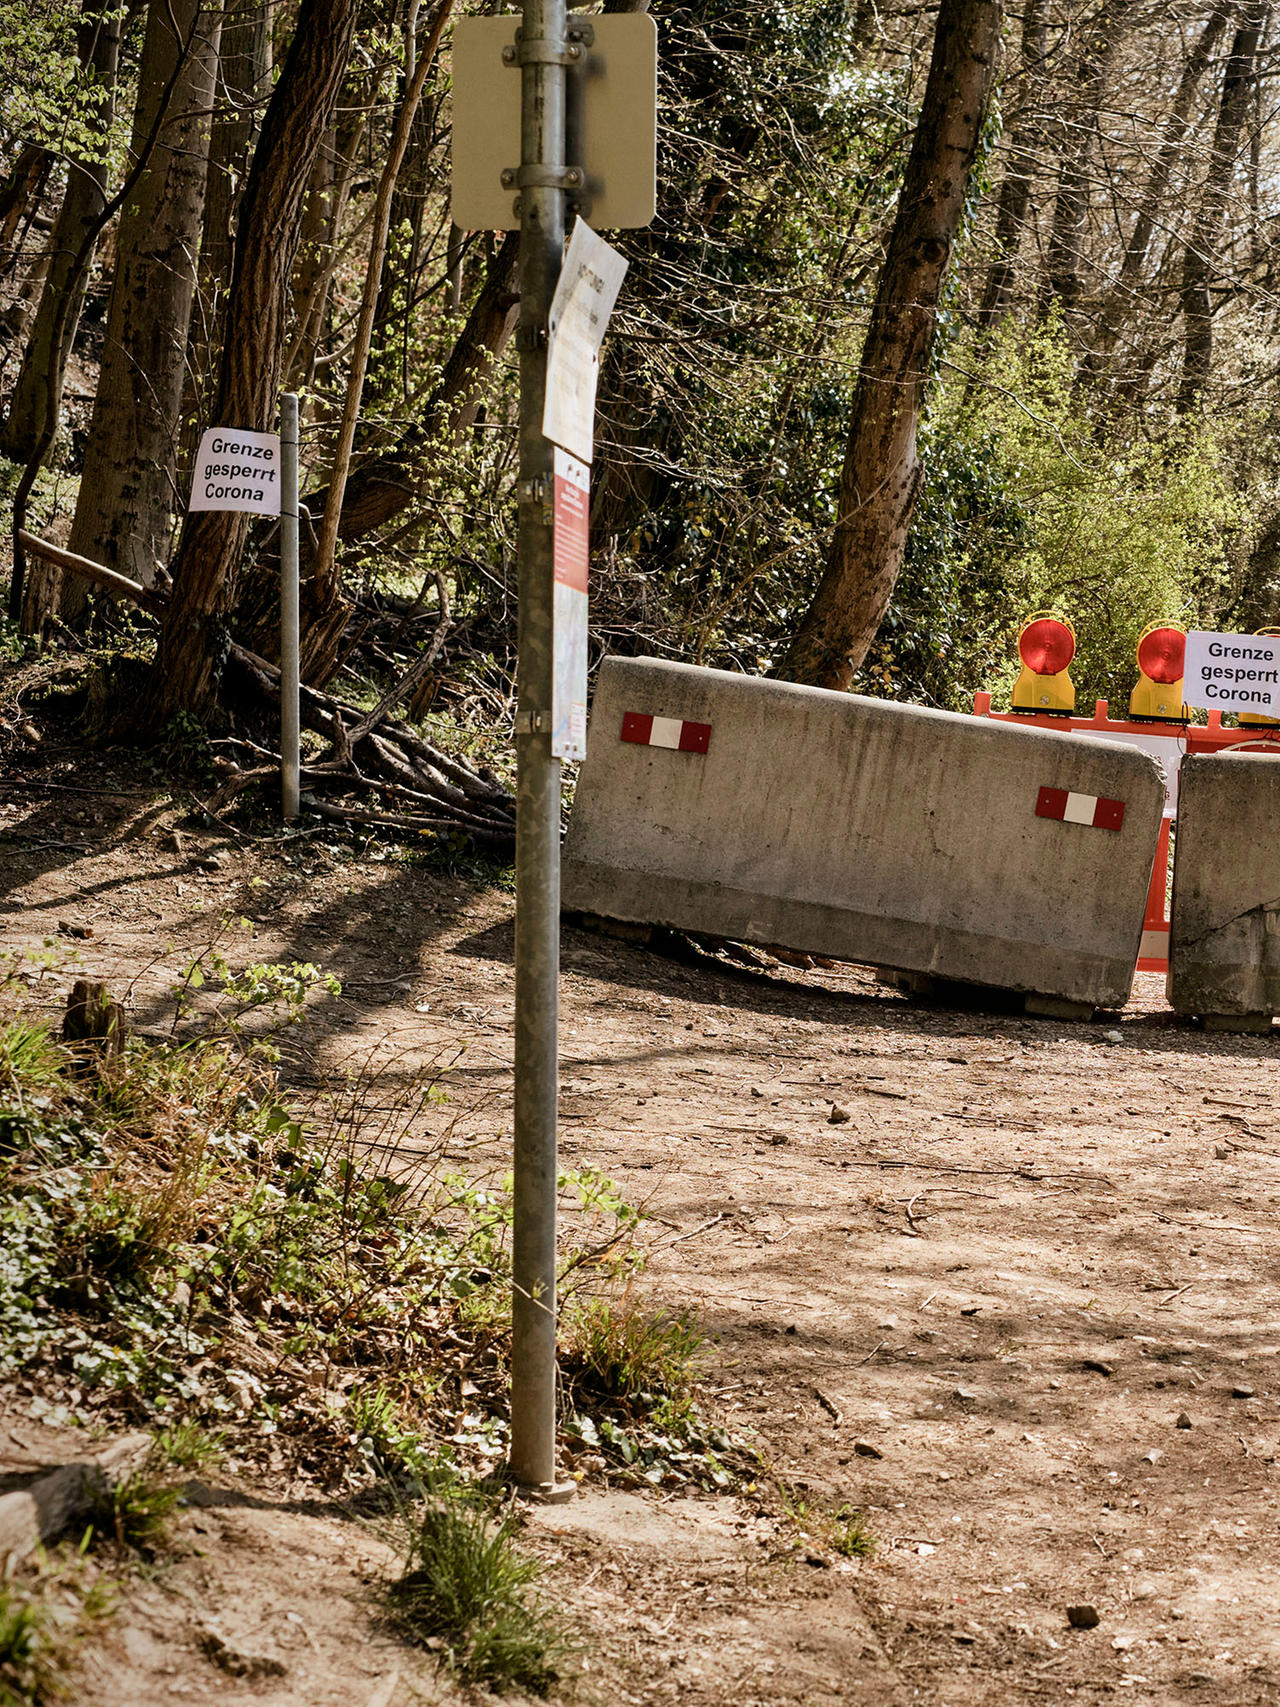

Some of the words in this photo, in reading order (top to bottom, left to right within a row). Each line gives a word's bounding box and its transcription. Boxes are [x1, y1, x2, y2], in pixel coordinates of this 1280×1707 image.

[211, 438, 274, 460] Grenze
[204, 464, 276, 482] gesperrt
[205, 483, 264, 501] Corona
[1208, 642, 1274, 661] Grenze
[1201, 665, 1279, 683] gesperrt
[1205, 684, 1272, 704] Corona
